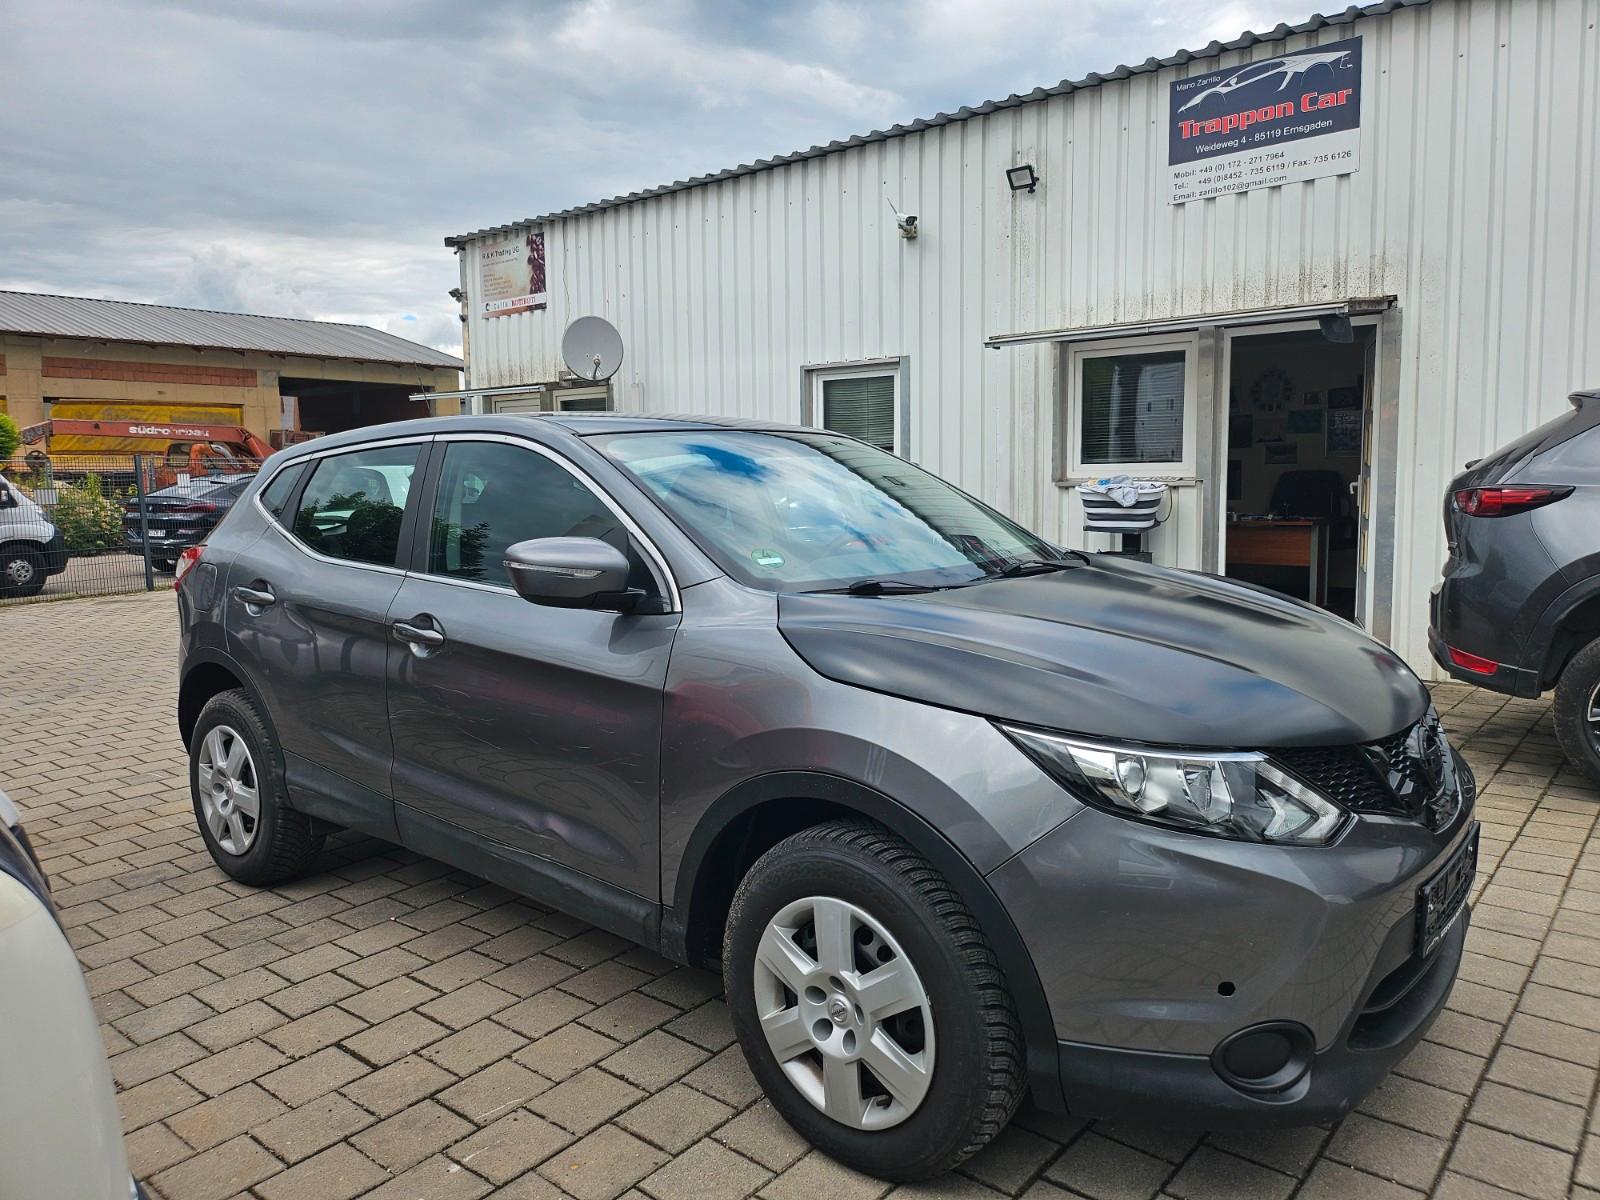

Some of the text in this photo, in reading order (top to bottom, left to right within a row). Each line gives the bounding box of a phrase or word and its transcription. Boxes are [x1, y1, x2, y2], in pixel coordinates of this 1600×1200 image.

[1178, 88, 1352, 139] Trappon Car
[1195, 137, 1239, 154] Weideweg
[1240, 136, 1247, 144] 4
[1254, 129, 1281, 142] 85119
[1173, 169, 1197, 180] Mobil:
[1199, 165, 1213, 174] +49
[1215, 163, 1225, 173] (0)
[1228, 160, 1242, 169] 172
[1248, 156, 1263, 165] 271
[1265, 151, 1285, 161] 7964
[1174, 182, 1189, 191] Tel.:
[1198, 177, 1212, 185] +49
[1250, 166, 1264, 176] 735
[1266, 162, 1285, 173] 6119
[1292, 158, 1311, 168] Fax:
[1313, 154, 1329, 164] 735
[1331, 150, 1352, 161] 6126
[1173, 191, 1197, 202] Email:
